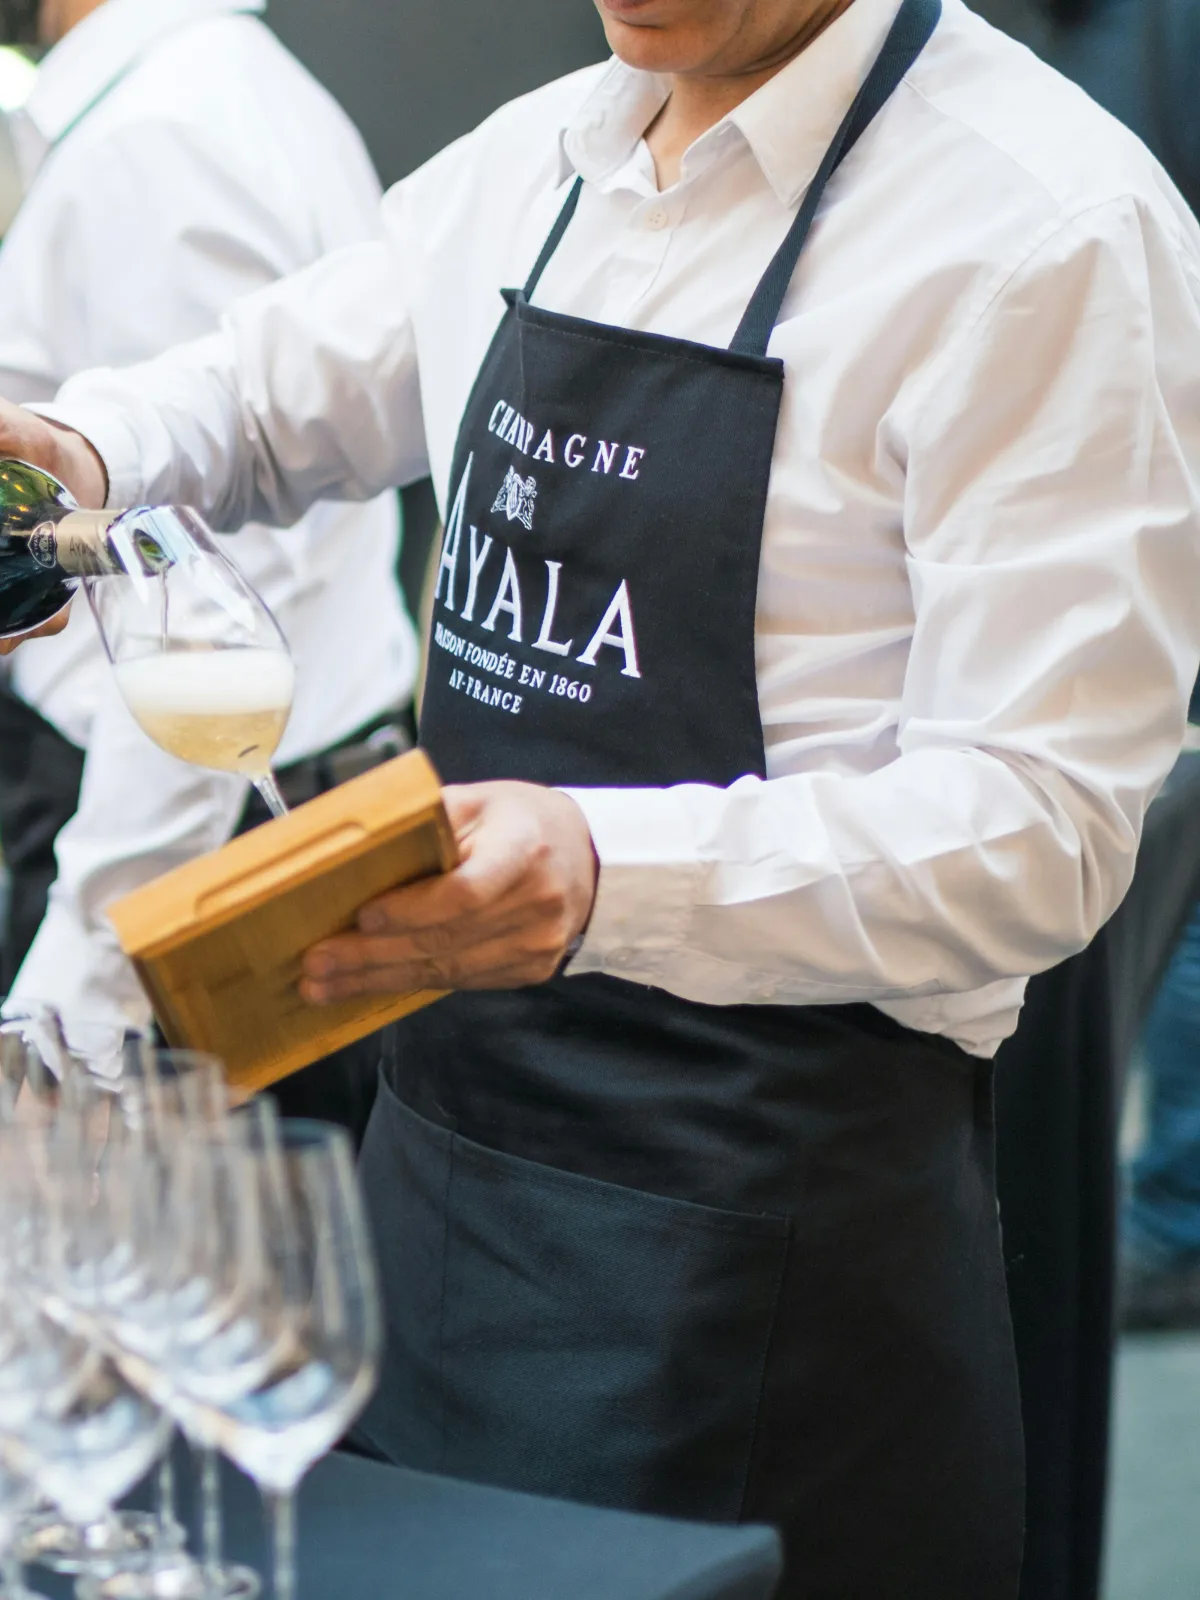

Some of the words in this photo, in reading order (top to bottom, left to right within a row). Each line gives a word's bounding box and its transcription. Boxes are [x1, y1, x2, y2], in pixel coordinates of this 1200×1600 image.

[434, 450, 642, 679] AYALA
[464, 642, 517, 679] FONDÉE
[517, 664, 546, 688] EN
[548, 674, 592, 703] 1860
